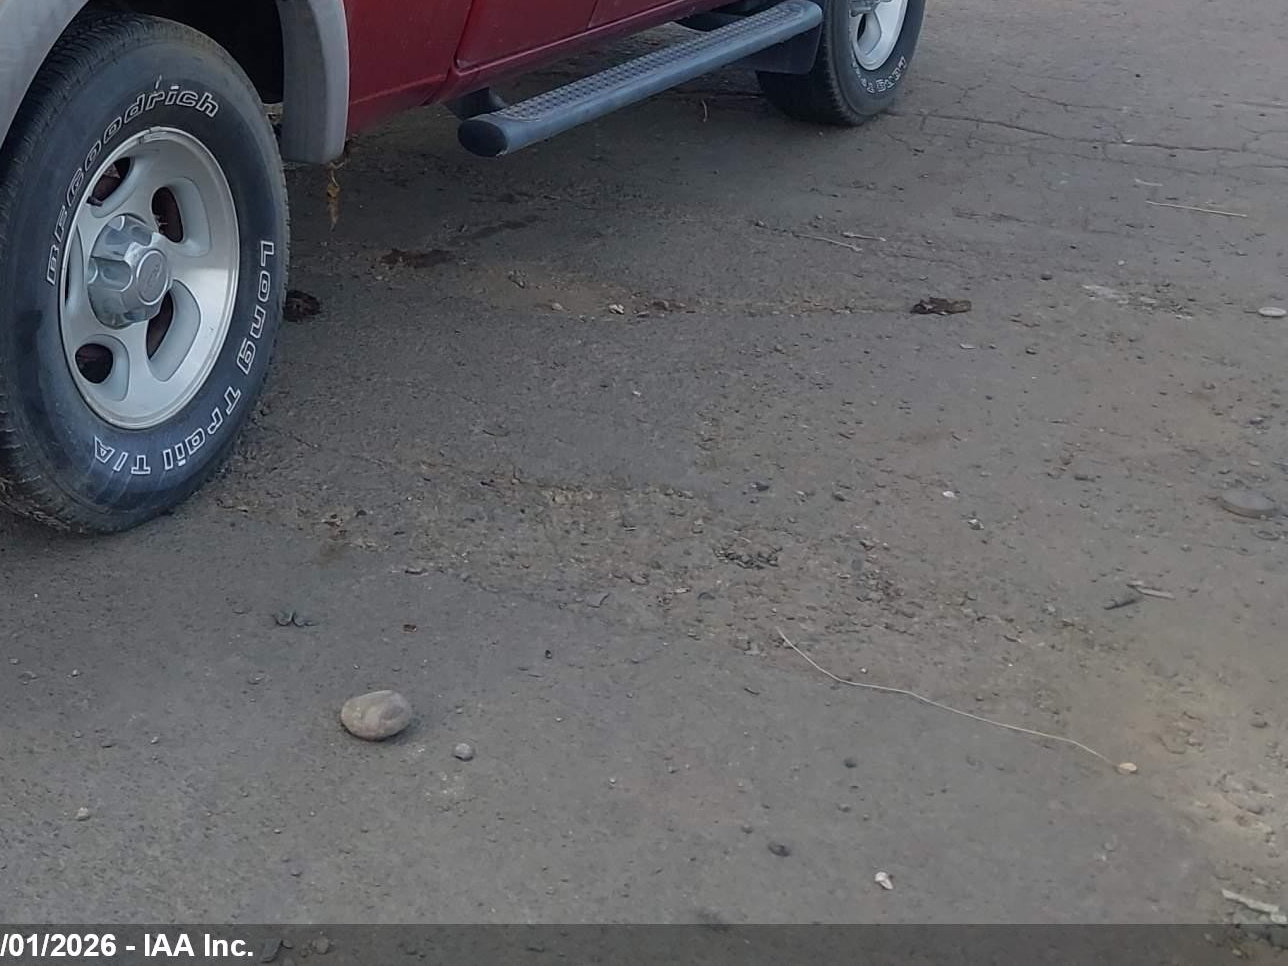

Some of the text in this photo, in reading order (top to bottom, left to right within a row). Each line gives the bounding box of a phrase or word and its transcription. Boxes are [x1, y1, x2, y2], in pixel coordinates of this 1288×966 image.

[46, 86, 219, 286] BFGoodrich
[94, 239, 275, 475] Long Trail T/A
